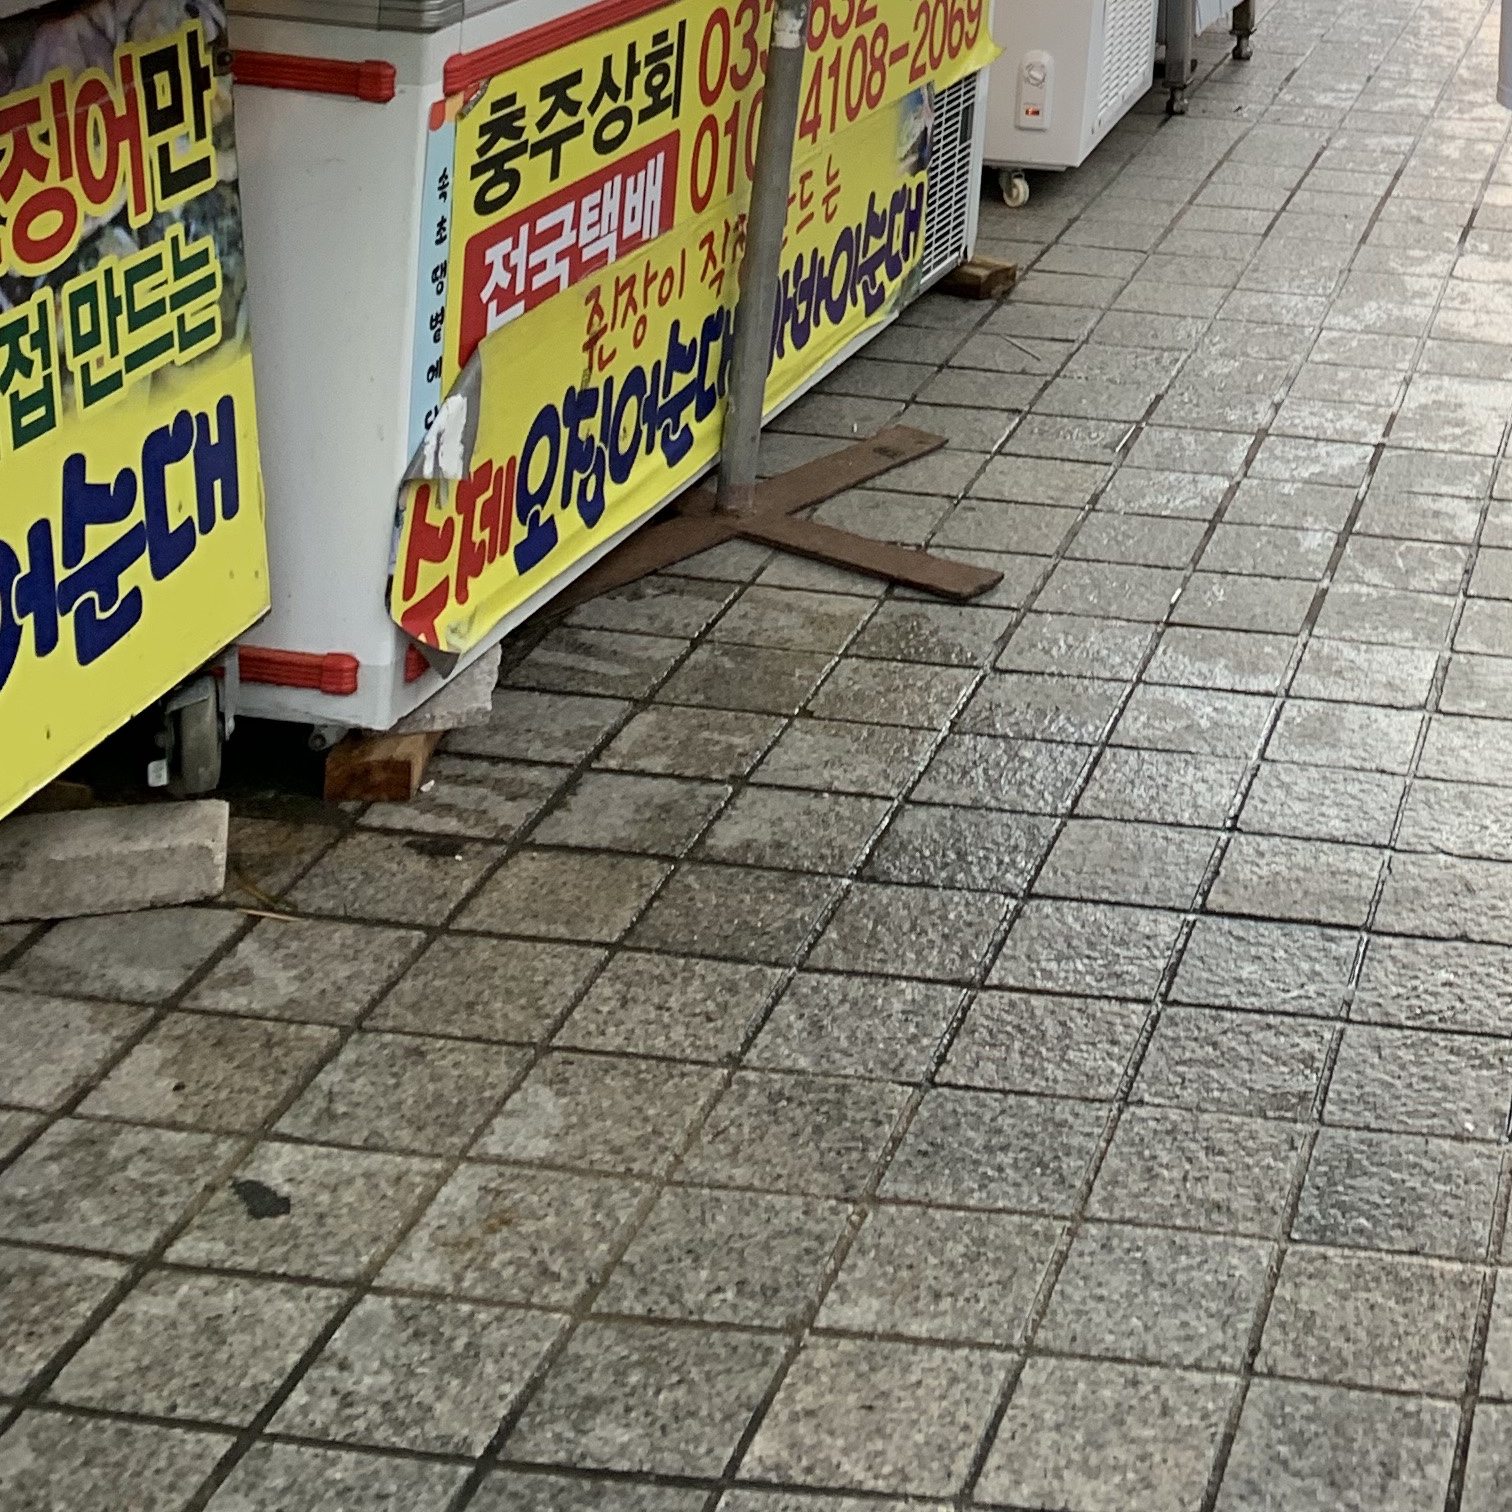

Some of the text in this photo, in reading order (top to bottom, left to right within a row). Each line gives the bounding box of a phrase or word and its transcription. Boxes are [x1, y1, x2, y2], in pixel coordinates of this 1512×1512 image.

[469, 19, 687, 216] 충주상회
[70, 234, 217, 396] 만드는
[481, 150, 667, 326] 전국택배
